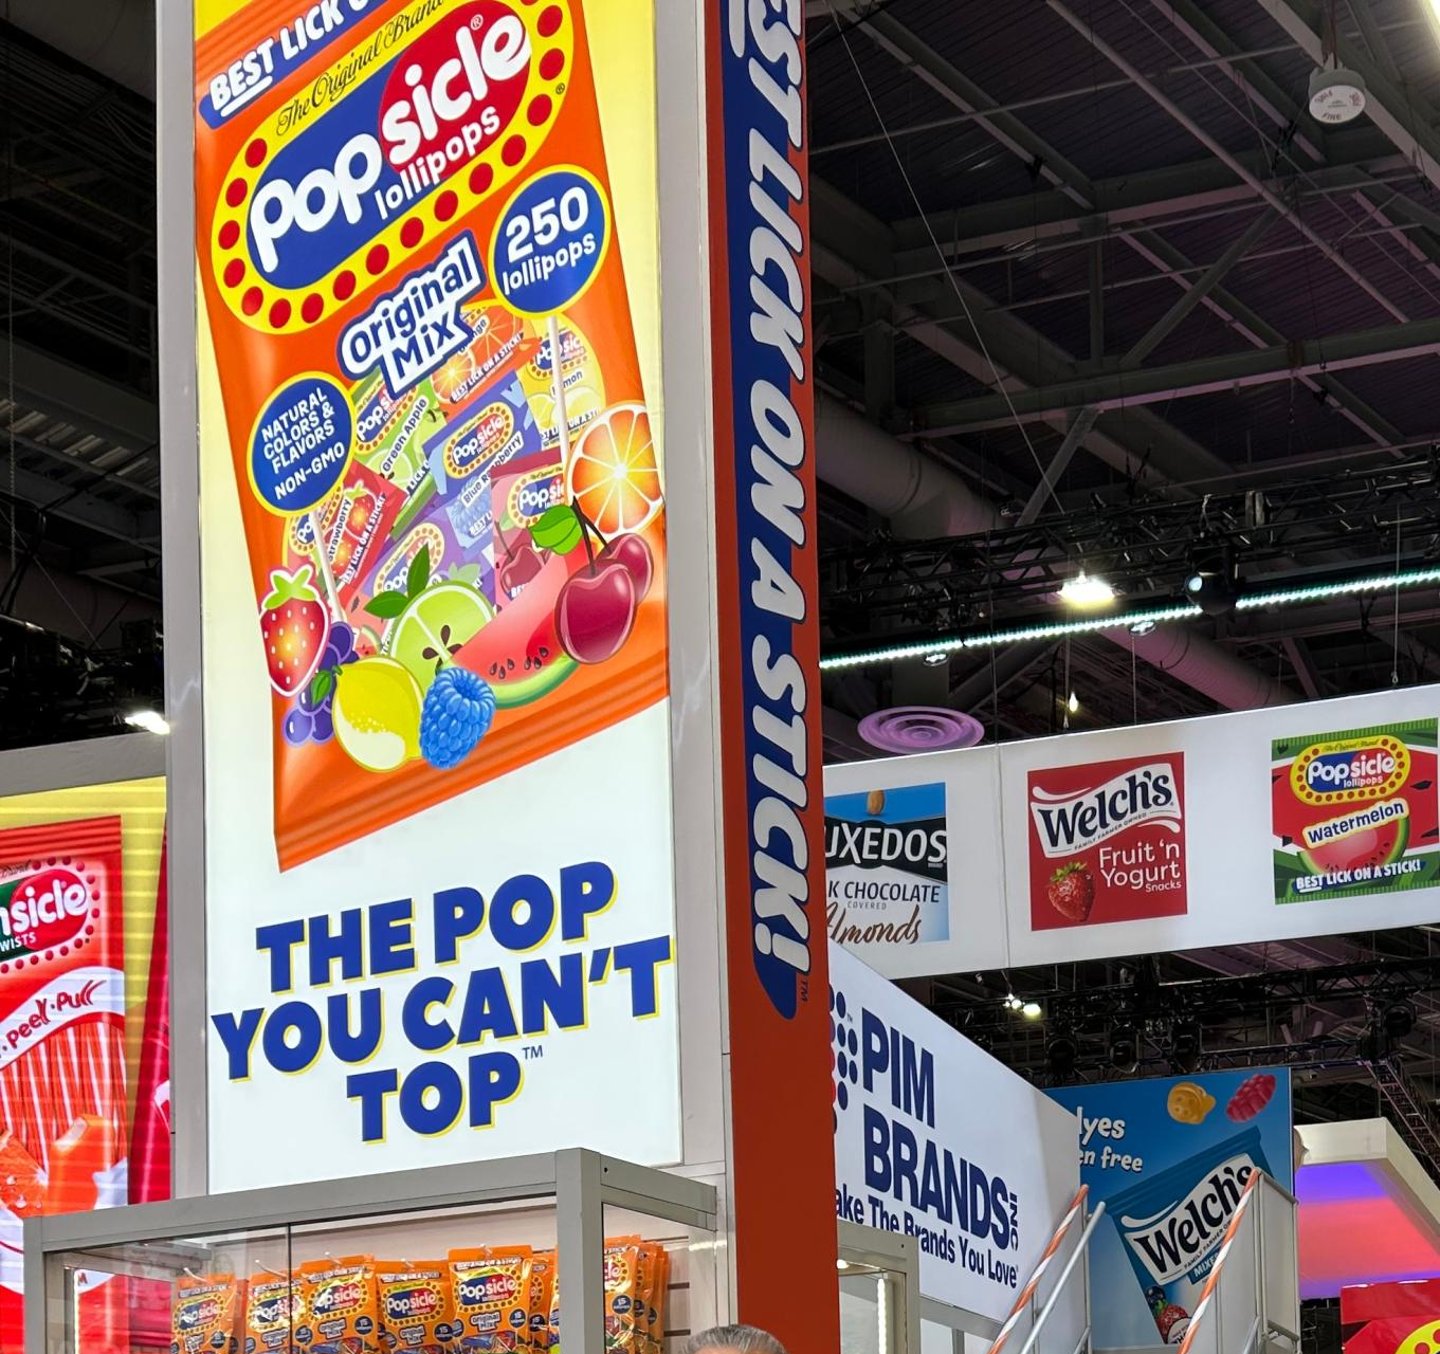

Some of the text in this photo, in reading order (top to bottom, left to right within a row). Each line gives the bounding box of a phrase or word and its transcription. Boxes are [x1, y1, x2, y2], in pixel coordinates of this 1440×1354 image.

[209, 0, 346, 112] BEST LICK
[276, 97, 311, 137] The
[310, 39, 382, 112] Original
[374, 106, 501, 220] lollipops
[505, 185, 590, 264] 250
[749, 128, 804, 381] LICK
[502, 232, 596, 295] lollipops
[392, 312, 455, 379] Mix
[262, 387, 327, 442] NATURAL
[264, 402, 335, 460] COLORS &
[272, 420, 335, 474] FLAVORS
[274, 442, 345, 500] NON-GMO
[750, 379, 806, 546] ON
[751, 537, 807, 620] A
[752, 634, 810, 973] STICK!
[1036, 769, 1173, 848] Welch's
[1343, 775, 1383, 789] lollipops
[1099, 842, 1155, 869] Fruit
[1100, 861, 1181, 890] Yogurt
[1145, 880, 1182, 893] Snacks
[1296, 875, 1323, 891] BEST
[1326, 870, 1351, 886] LICK
[1354, 867, 1372, 881] ON
[1385, 858, 1421, 877] STICK!
[844, 881, 940, 903] CHOCOLATE
[847, 901, 887, 911] COVERED
[255, 860, 617, 995] THE POP
[211, 935, 675, 1081] YOU CAN'T
[862, 1007, 935, 1129] PIM
[864, 1103, 1010, 1251] BRANDS
[1101, 1146, 1143, 1172] free
[835, 1183, 1018, 1289] ake The Brands You Love
[1009, 1192, 1019, 1251] INC
